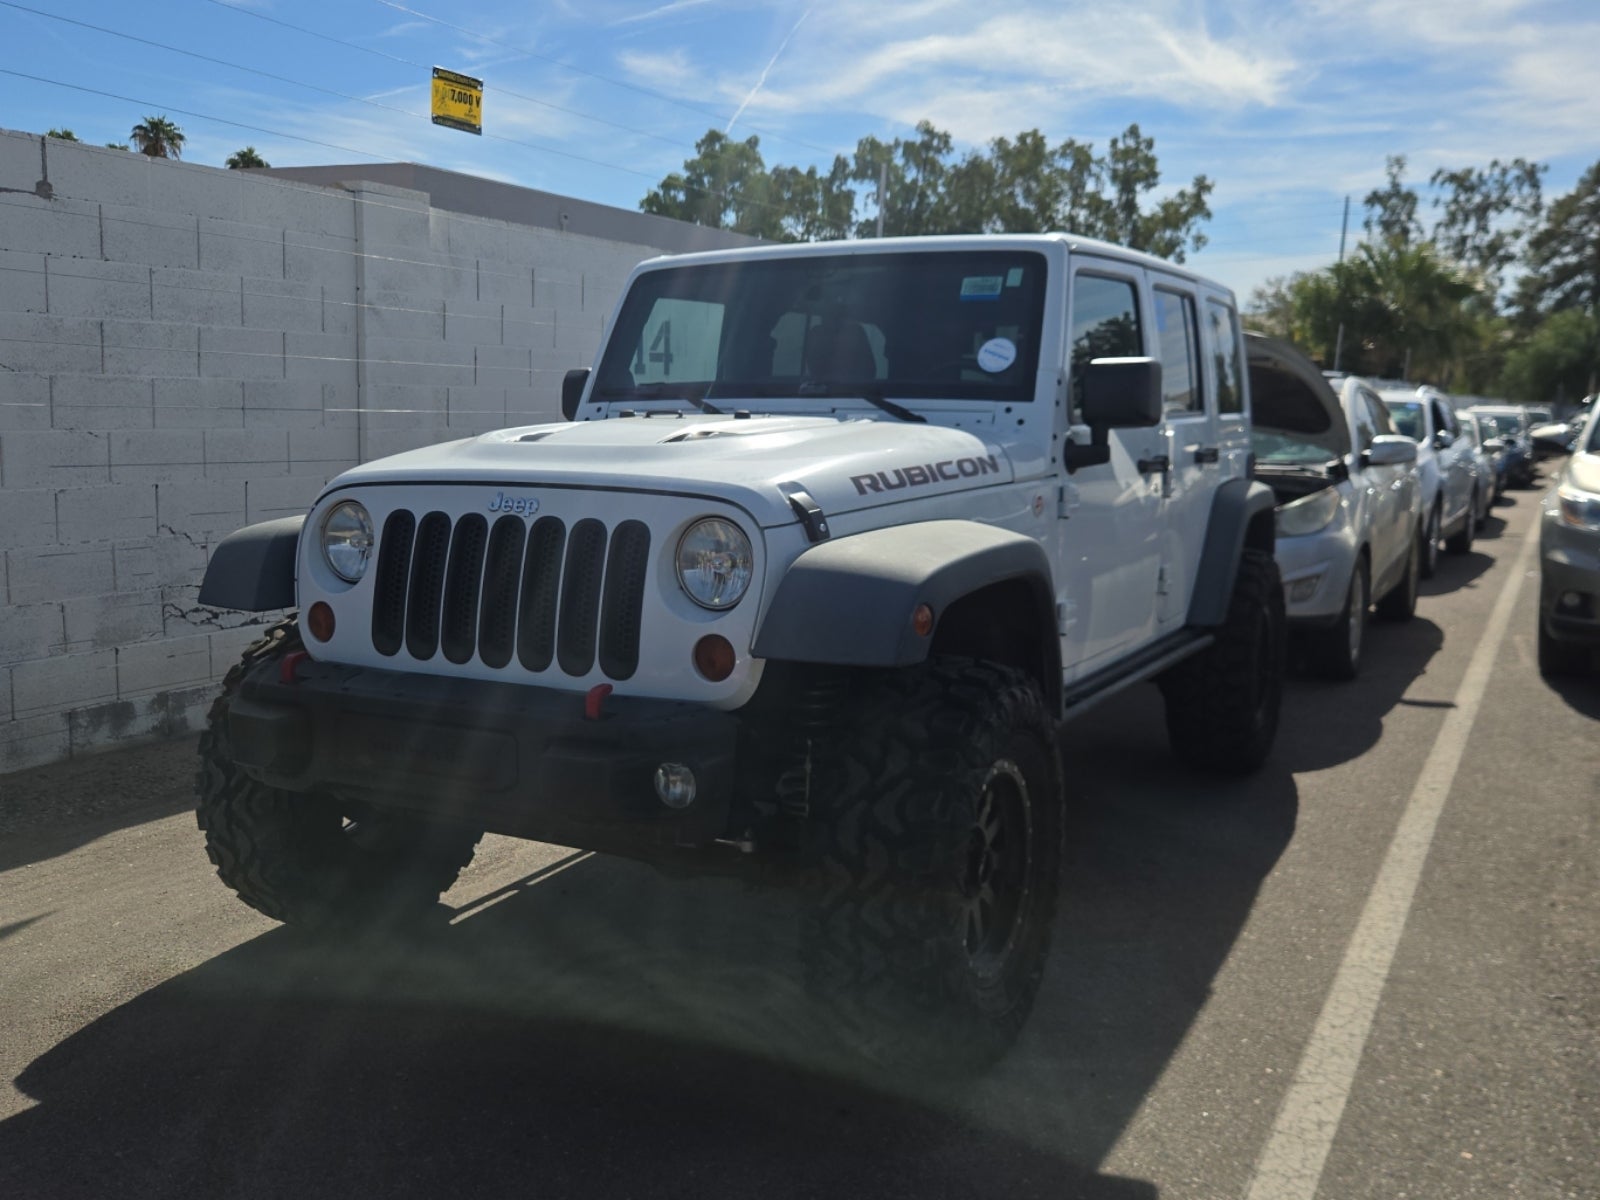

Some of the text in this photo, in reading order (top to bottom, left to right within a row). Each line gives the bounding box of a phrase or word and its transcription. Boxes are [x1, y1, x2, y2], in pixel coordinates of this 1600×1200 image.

[450, 89, 481, 108] 7,000 V
[850, 454, 999, 495] RUBICON
[488, 491, 539, 517] Jeep
